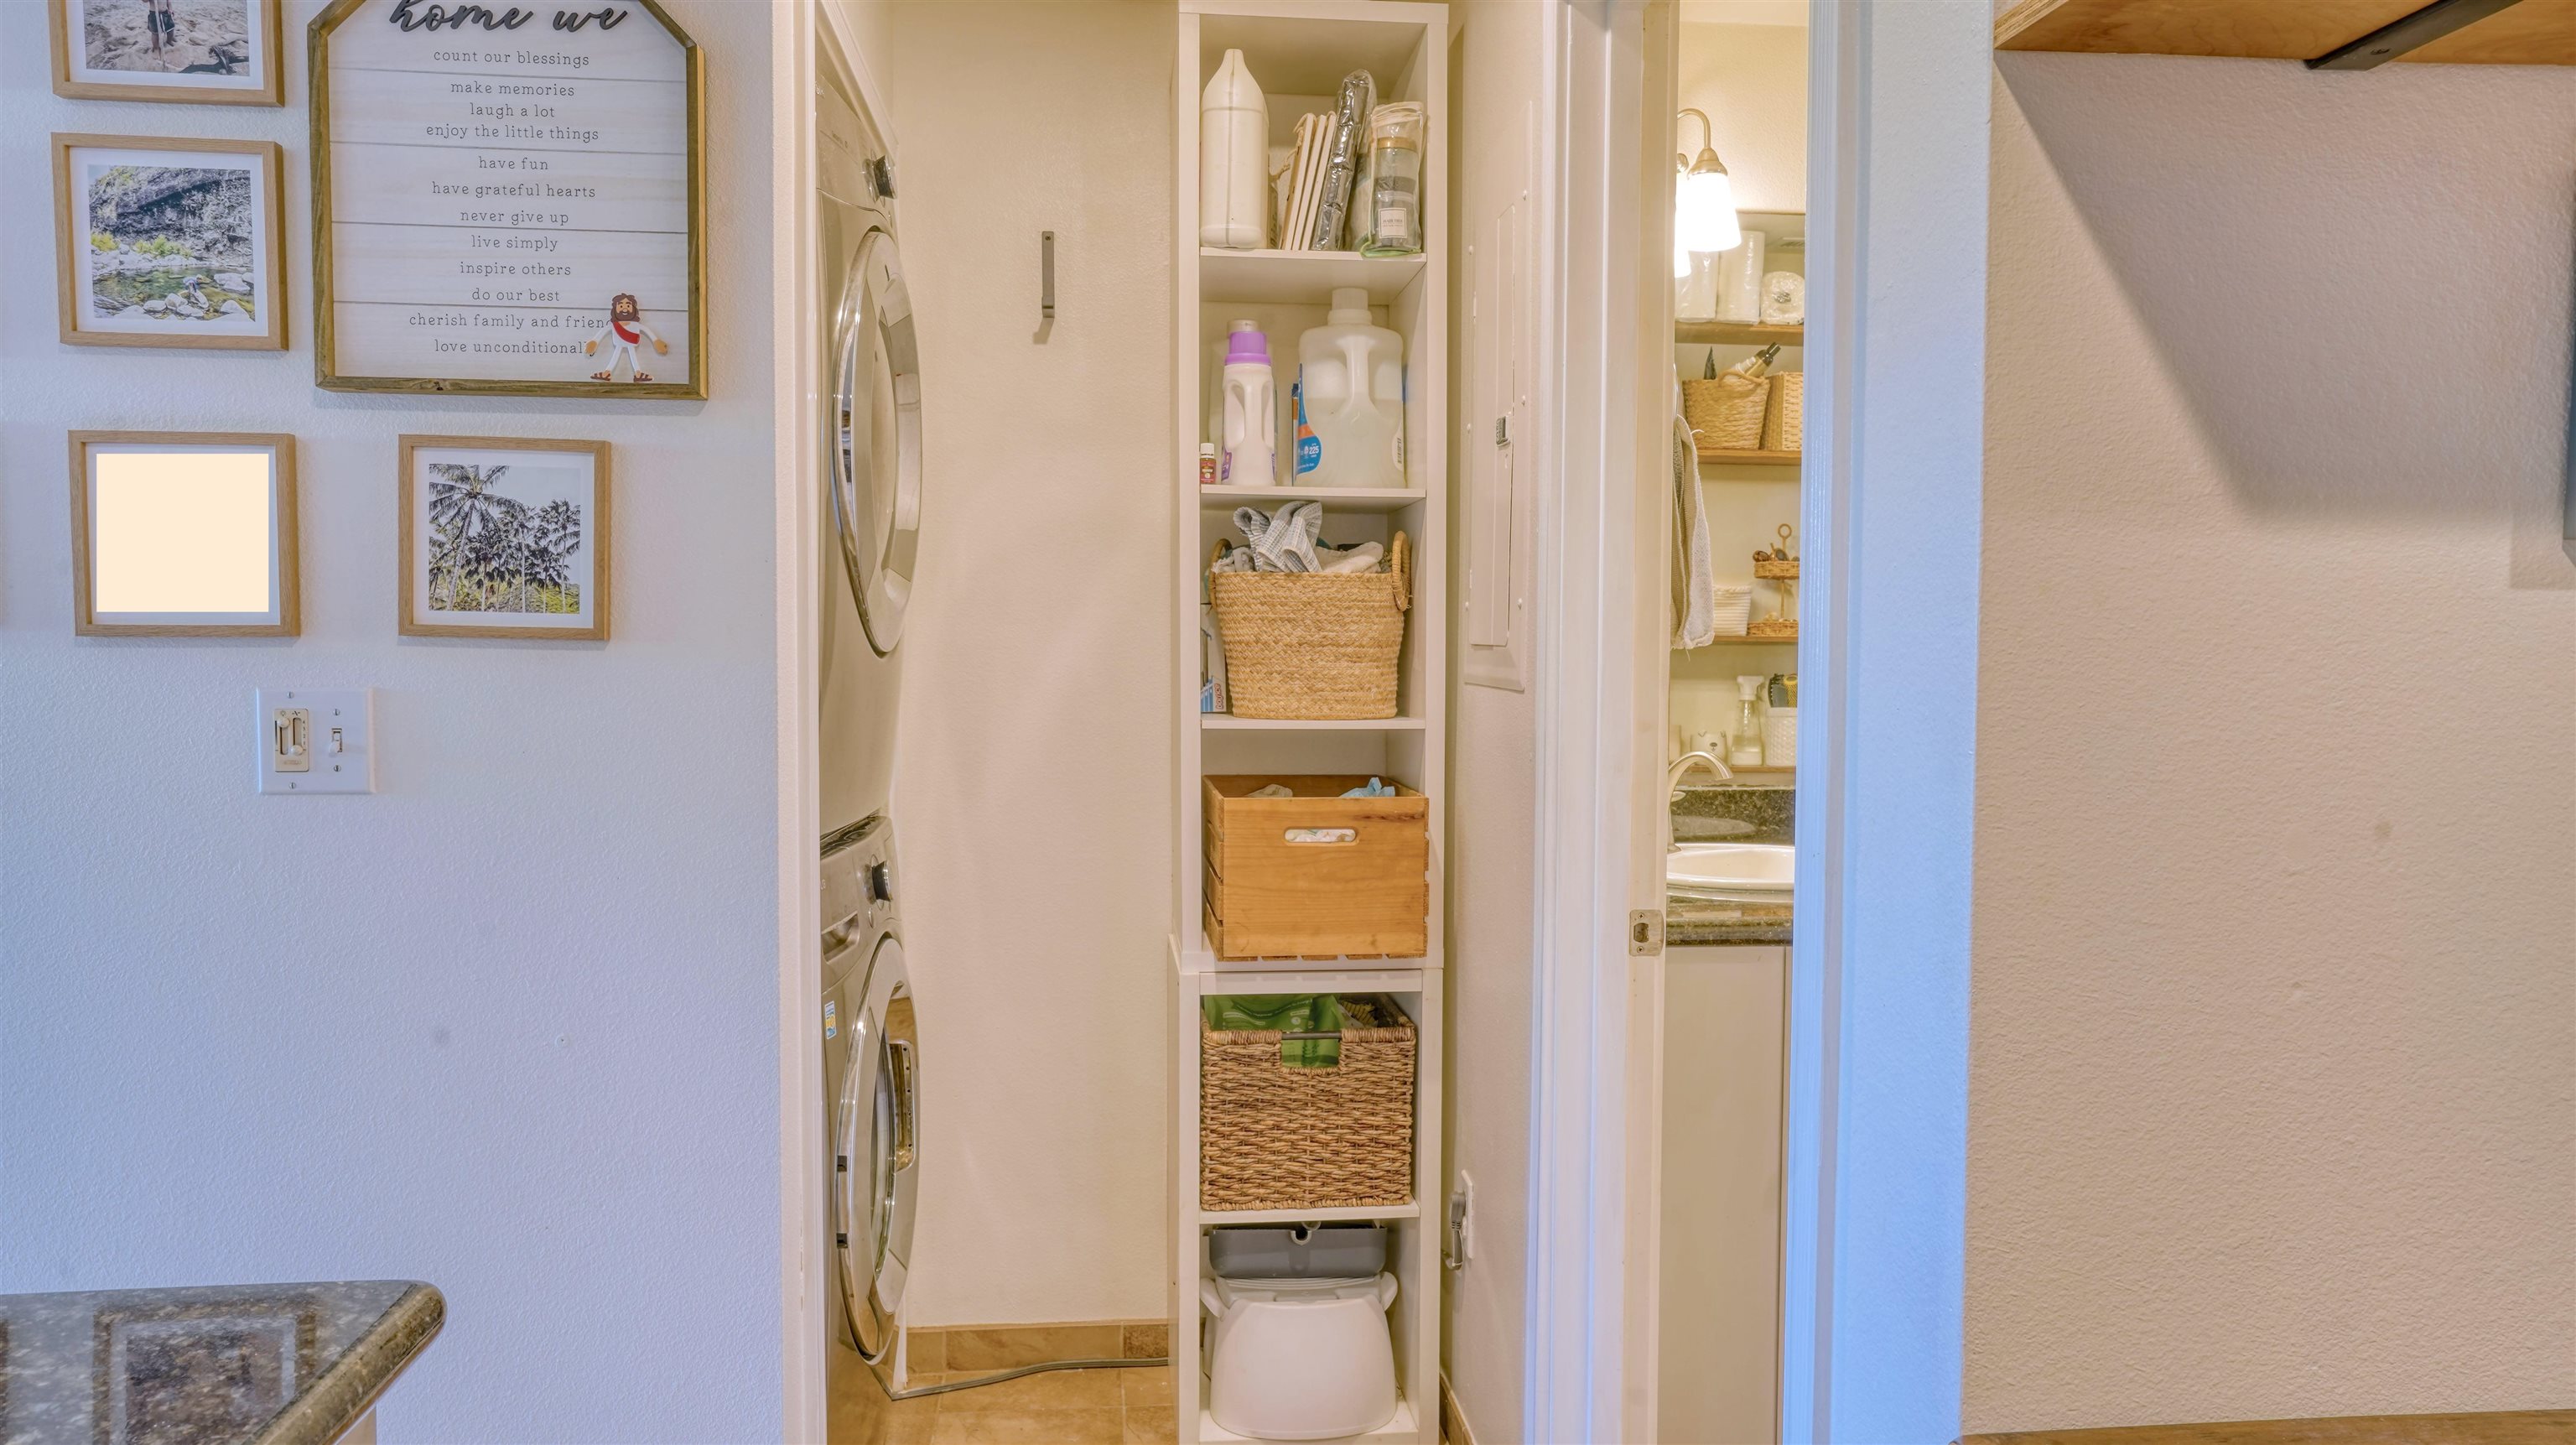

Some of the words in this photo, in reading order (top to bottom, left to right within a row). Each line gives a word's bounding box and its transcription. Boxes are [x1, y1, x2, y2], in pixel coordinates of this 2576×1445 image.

[389, 0, 534, 33] home
[553, 7, 628, 33] we
[434, 50, 478, 62] count
[484, 53, 511, 63] our
[516, 50, 589, 70] blessings
[450, 80, 492, 94] make
[498, 83, 575, 96] memories
[470, 101, 515, 120] laugh
[520, 107, 529, 117] a
[533, 103, 555, 118] lot
[426, 122, 469, 139] enjoy
[474, 123, 500, 138] the
[504, 124, 543, 139] little
[549, 126, 599, 144] things
[478, 155, 516, 169] have
[521, 157, 549, 170] fun
[432, 180, 470, 195] have
[475, 183, 541, 199] grateful
[545, 184, 595, 198] hearts
[460, 211, 505, 222] never
[511, 210, 544, 226] give
[549, 214, 569, 226] up
[470, 234, 501, 248] live
[506, 236, 558, 252] simply
[460, 261, 516, 278] inspire
[522, 262, 571, 276] others
[471, 287, 491, 301] do
[496, 291, 523, 301] our
[528, 288, 560, 302] best
[409, 312, 468, 326] cherish
[473, 313, 525, 330] family
[531, 314, 559, 328] and
[564, 316, 611, 330] frien
[434, 338, 467, 352] love
[473, 340, 596, 357] unconditional
[1309, 445, 1319, 455] 225
